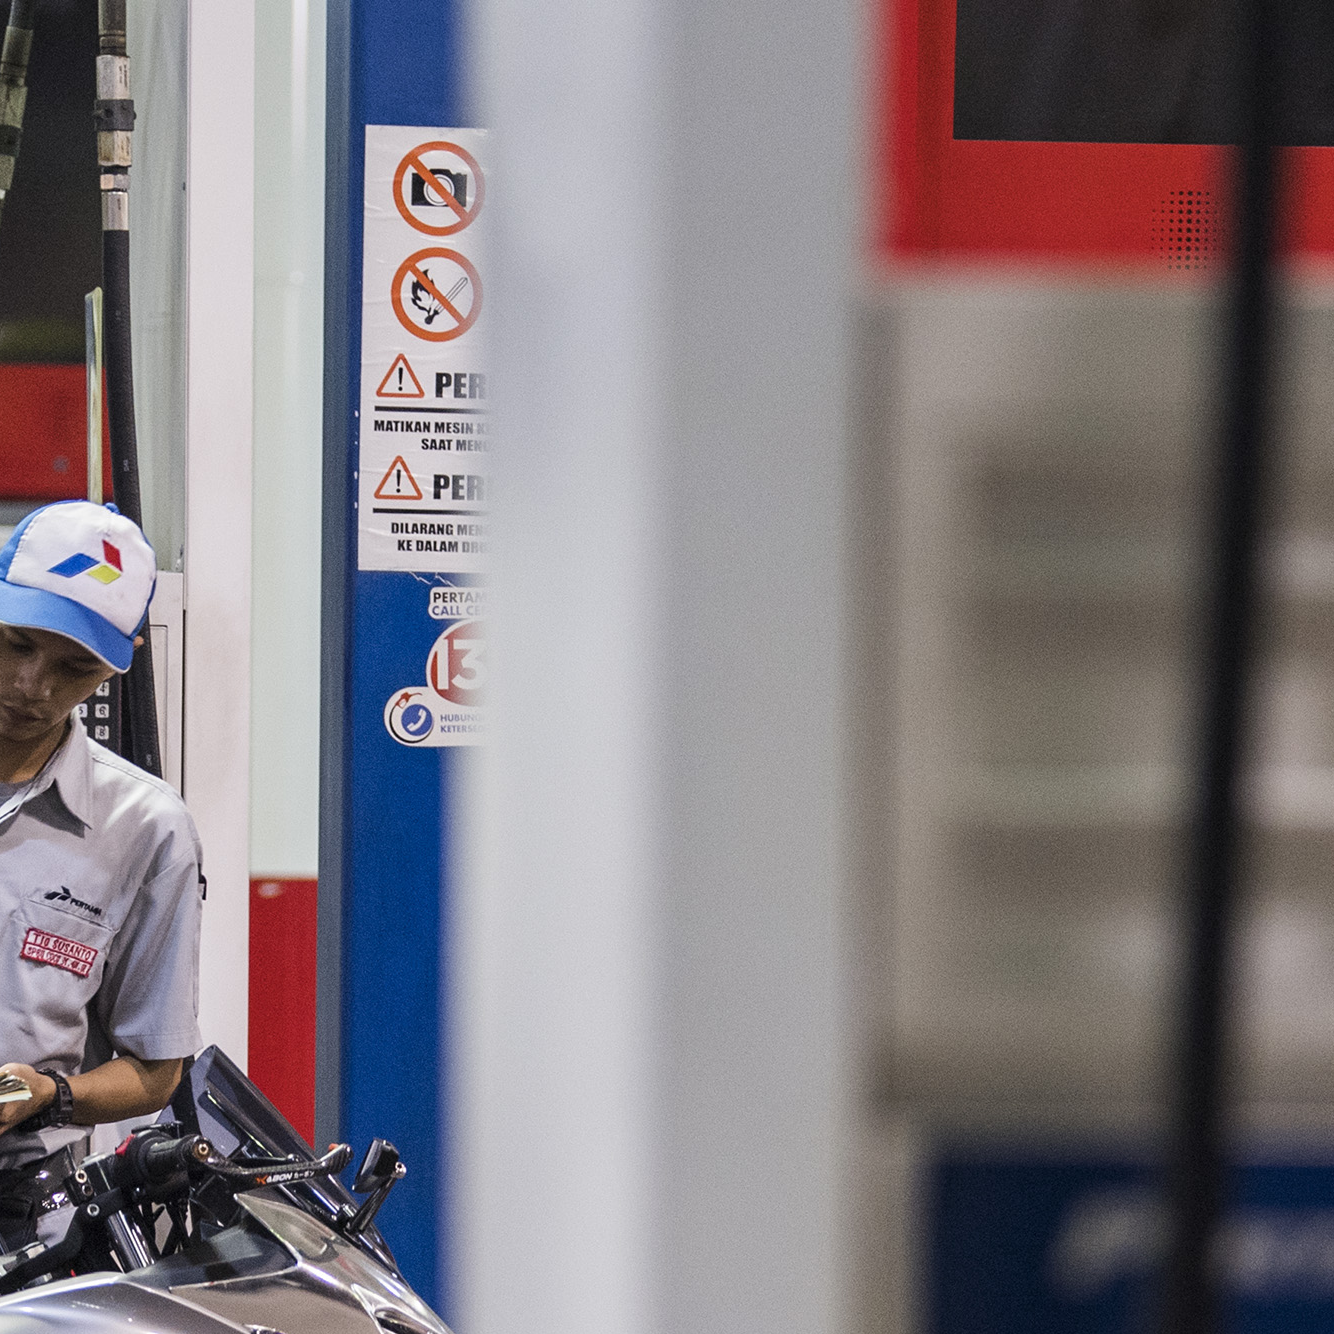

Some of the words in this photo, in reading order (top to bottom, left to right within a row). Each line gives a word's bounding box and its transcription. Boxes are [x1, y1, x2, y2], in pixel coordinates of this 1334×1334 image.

[374, 420, 431, 434] MATIKAN
[434, 421, 474, 434] MESIN
[421, 438, 452, 451] SAAT
[391, 521, 454, 535] DILARANG
[397, 539, 412, 551] KE
[416, 540, 459, 552] DALAM
[433, 591, 486, 603] PERTAM
[432, 604, 461, 616] CALL
[433, 637, 487, 690] 13
[99, 706, 106, 715] 6
[99, 728, 106, 736] 8
[33, 933, 50, 947] TIO
[52, 939, 92, 960] SUSANTO
